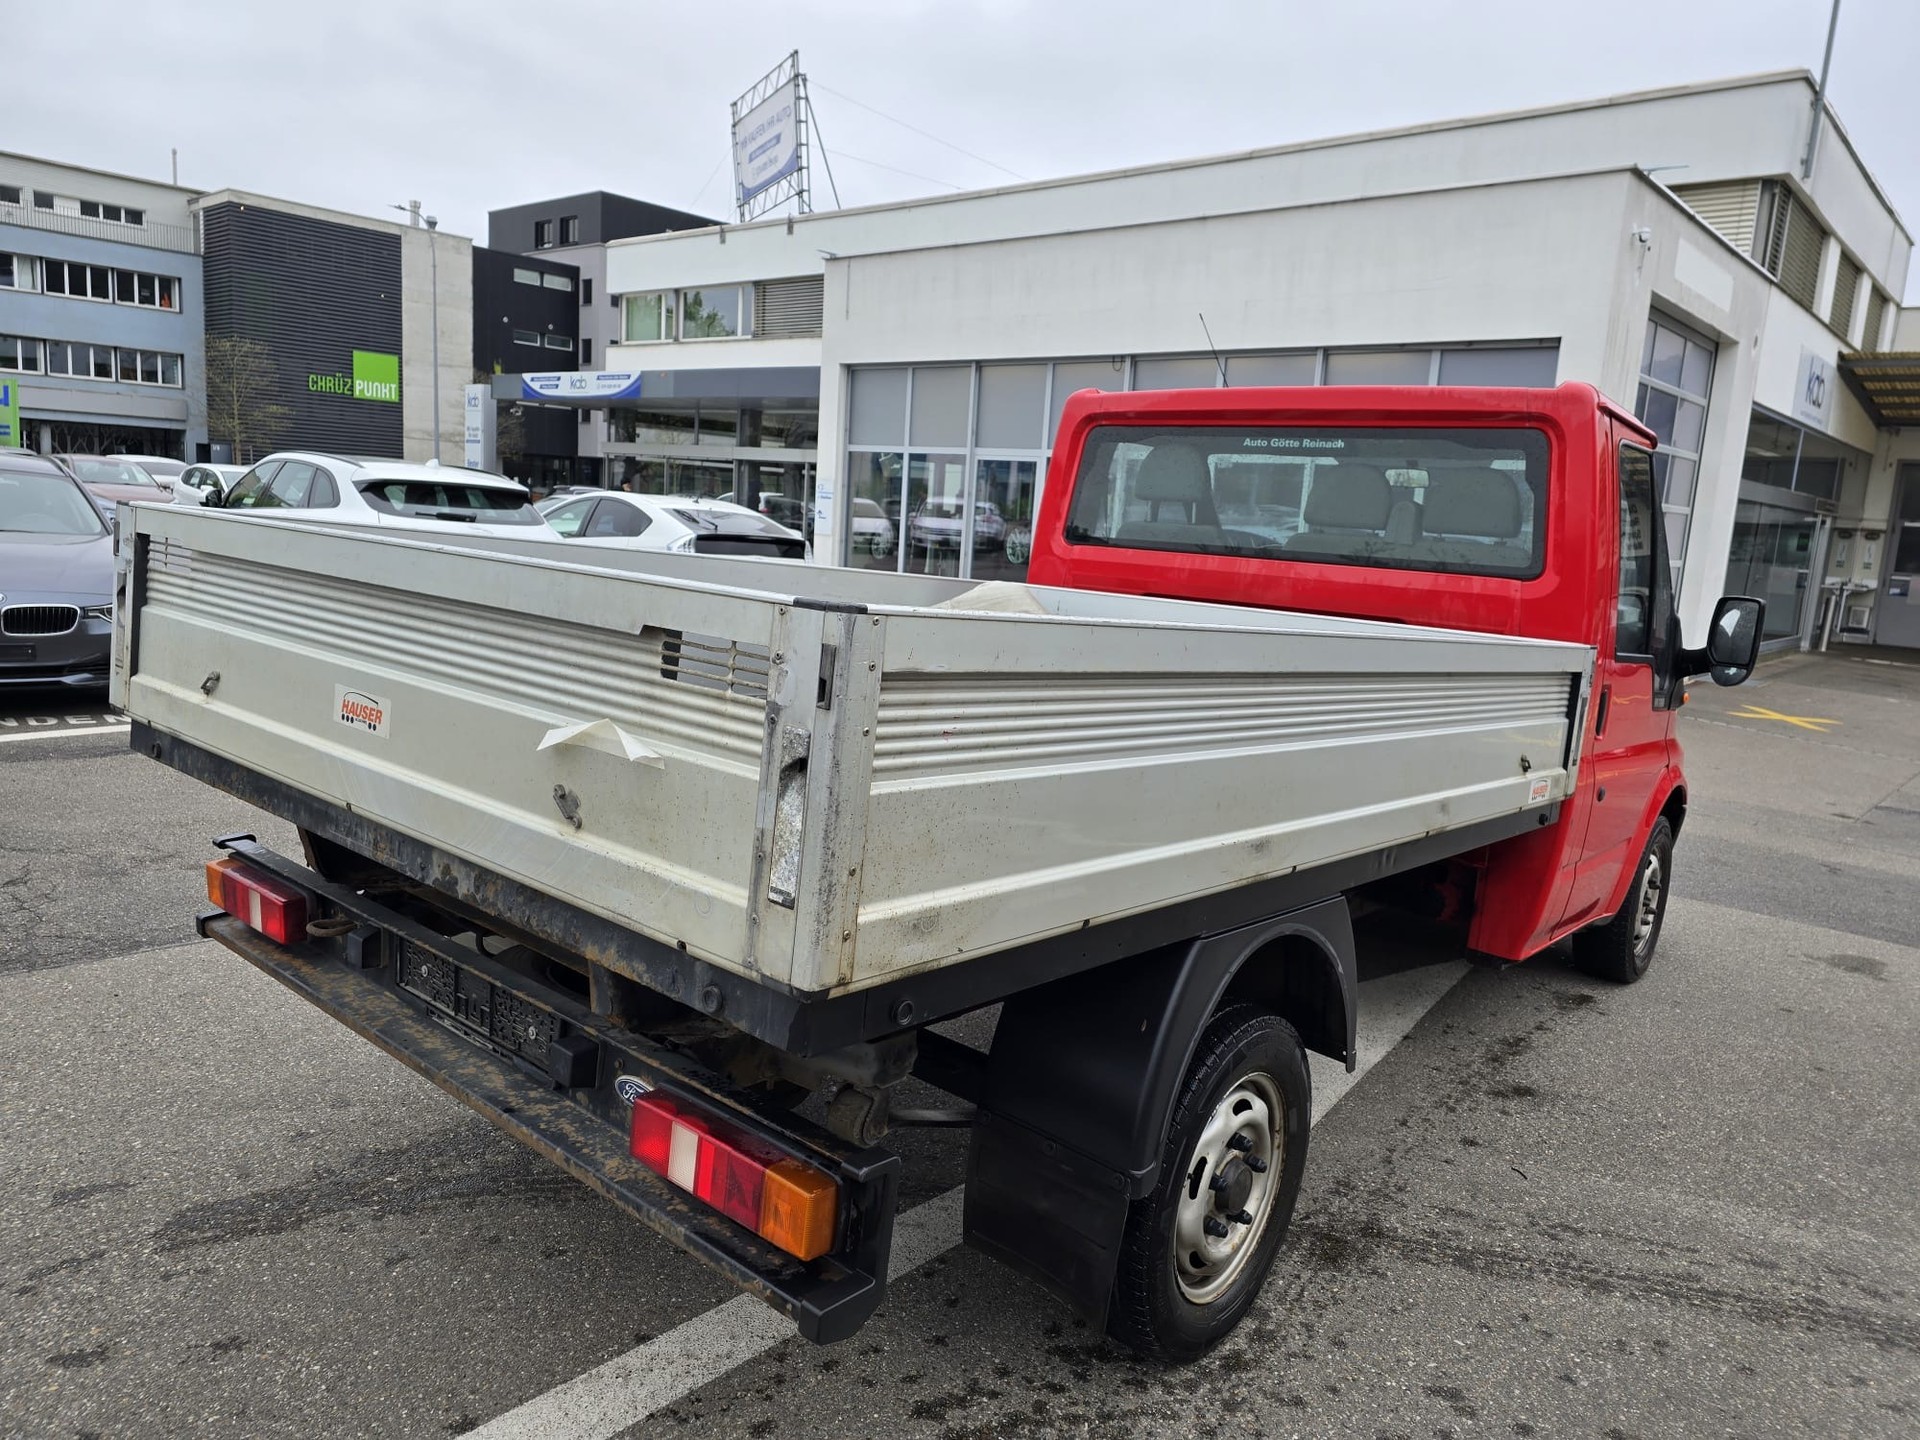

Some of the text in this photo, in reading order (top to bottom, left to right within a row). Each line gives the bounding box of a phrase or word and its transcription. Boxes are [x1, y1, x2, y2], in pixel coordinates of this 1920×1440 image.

[308, 373, 397, 400] CHRÜZ PUNKT
[569, 375, 588, 390] kab
[1805, 356, 1826, 409] kab
[1243, 438, 1345, 449] Auto Götte Reinach
[341, 698, 383, 726] HAUSER
[622, 1082, 645, 1103] Fo
